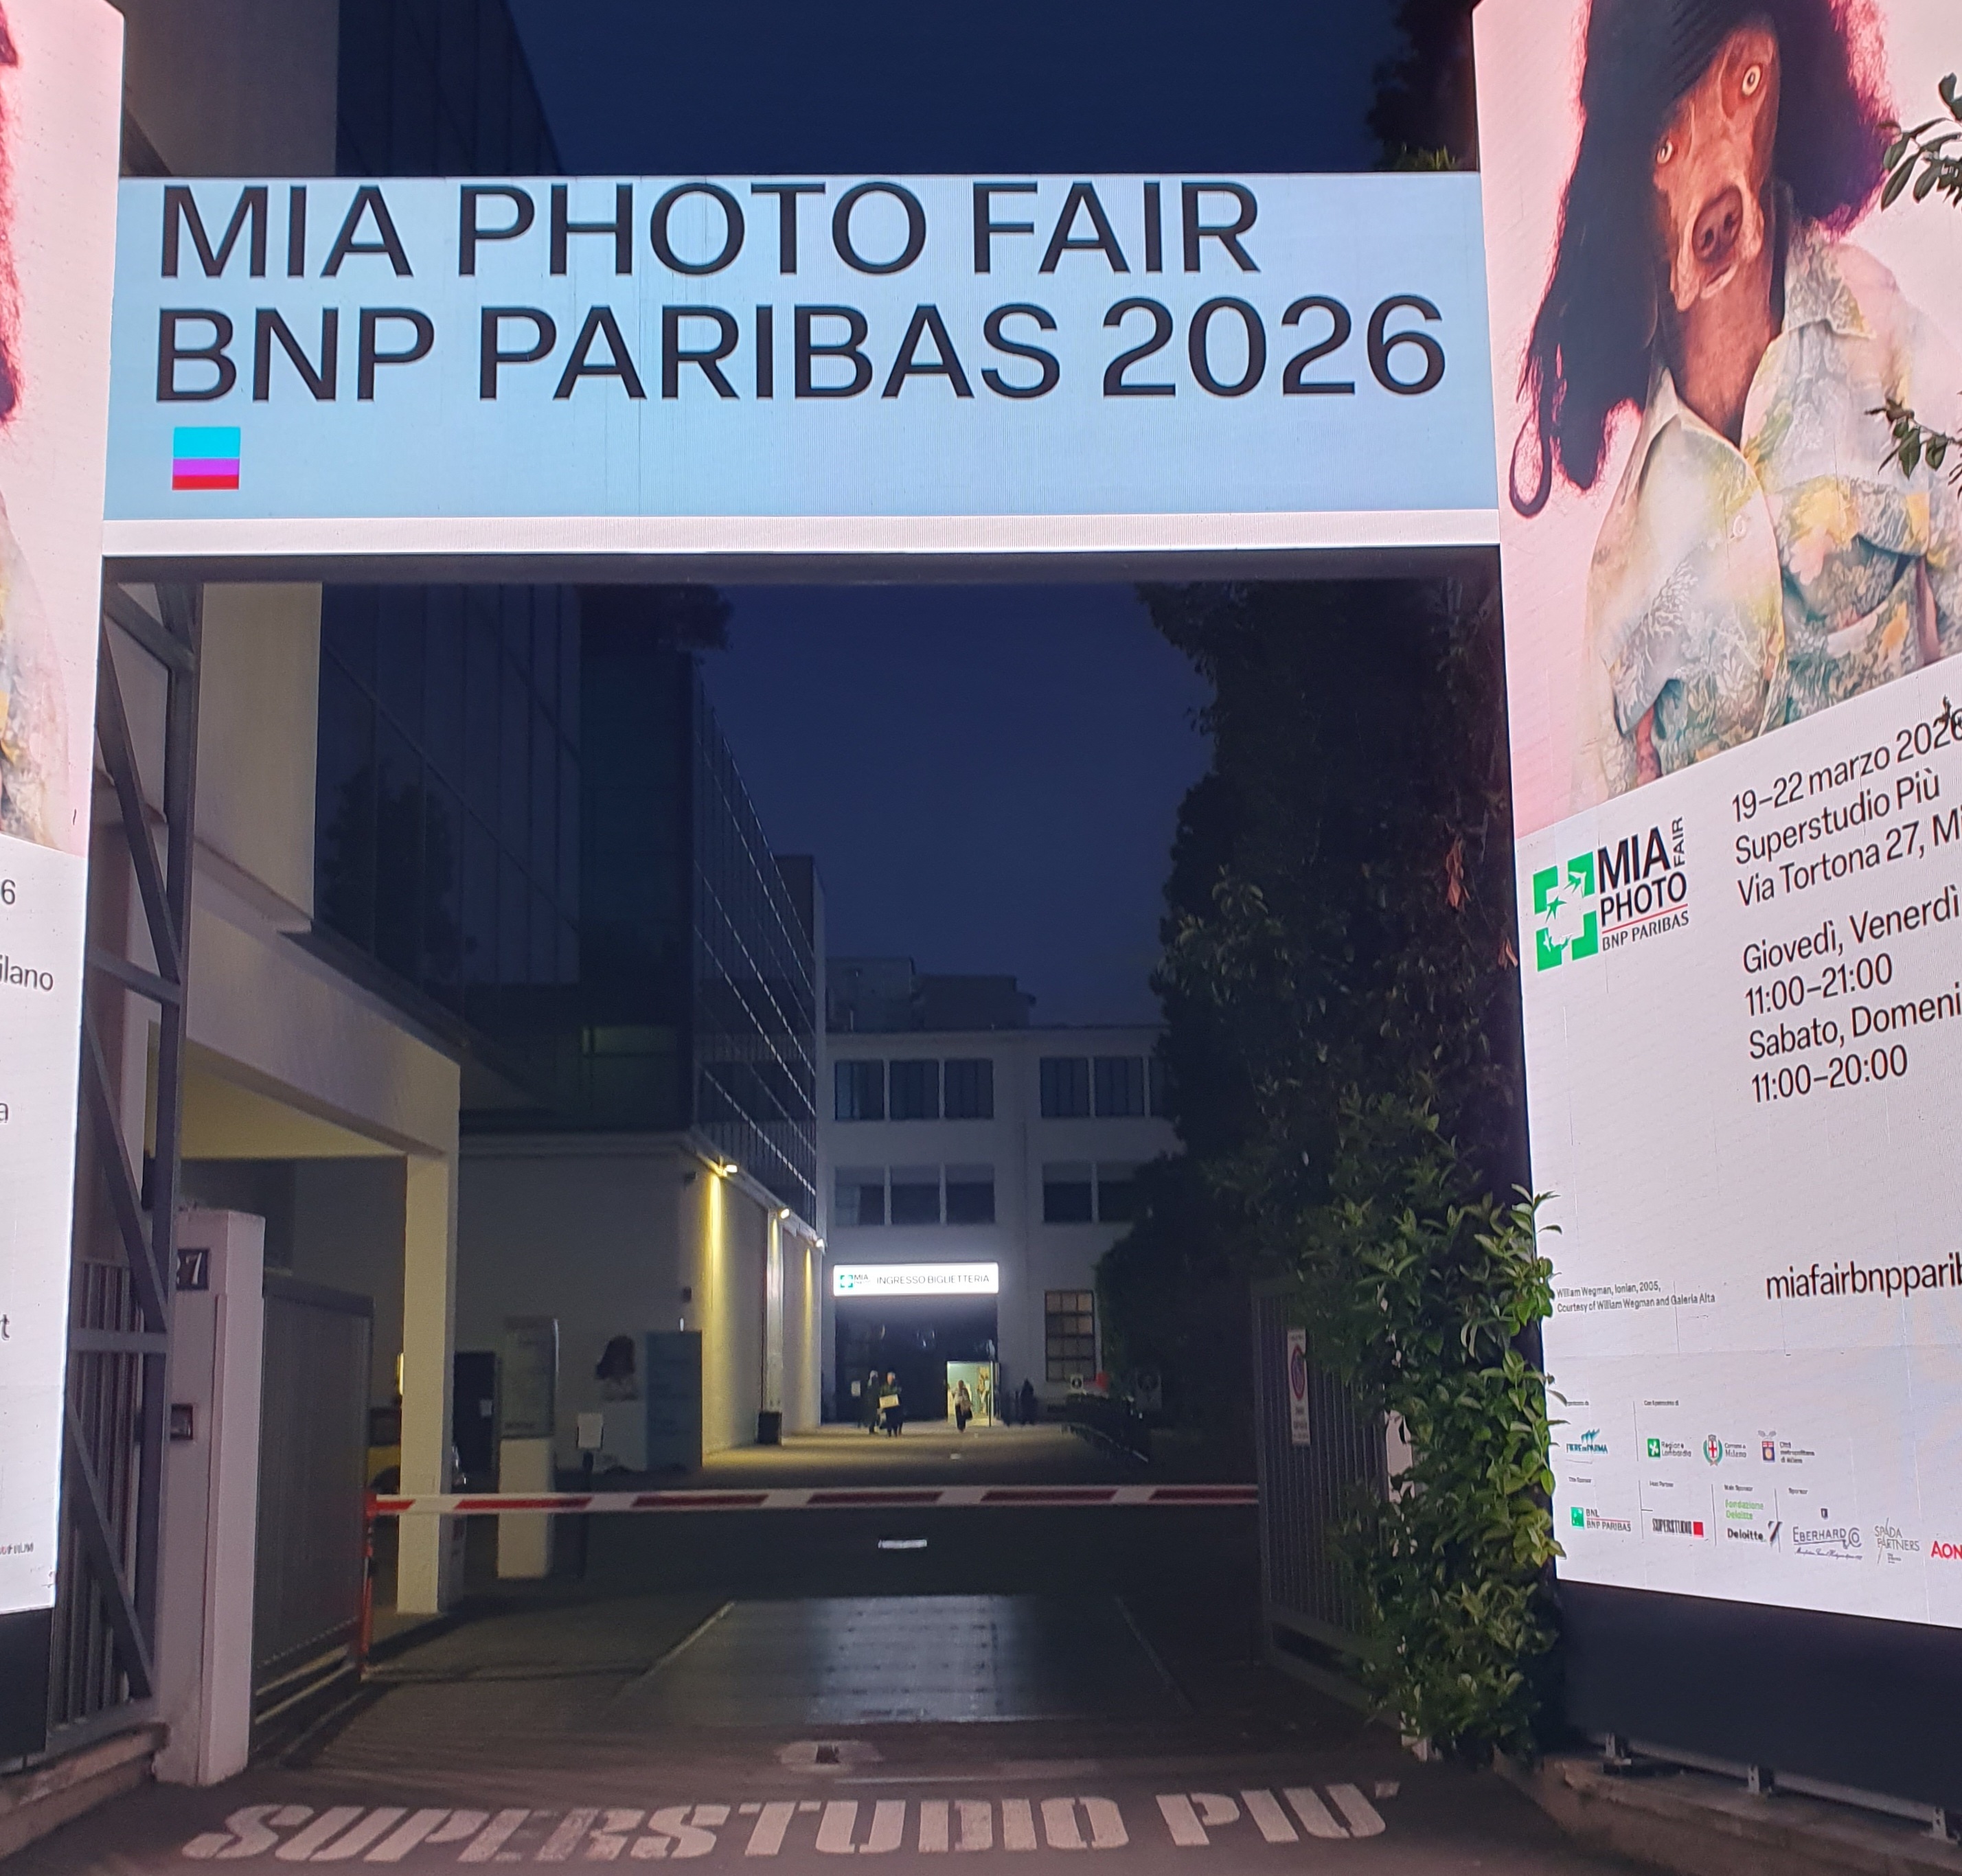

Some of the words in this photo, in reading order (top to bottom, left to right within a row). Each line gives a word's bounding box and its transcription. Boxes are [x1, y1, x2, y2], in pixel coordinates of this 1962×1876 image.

[161, 185, 414, 278] MIA
[457, 181, 927, 277] PHOTO
[972, 181, 1261, 274] FAIR
[157, 306, 435, 403] BNP
[479, 302, 1061, 400] PARIBAS
[1102, 293, 1446, 398] 2026
[1809, 746, 1890, 796] marzo
[1672, 816, 1685, 867] FAIR
[1735, 788, 1889, 865] Superstudio
[1896, 767, 1940, 810] Più
[1597, 826, 1672, 895] MIA
[1737, 872, 1775, 906] Via
[1779, 843, 1880, 893] Tortona
[1885, 820, 1924, 861] 27,
[1600, 871, 1687, 928] PHOTO
[1602, 930, 1628, 952] BNP
[1632, 910, 1689, 942] PARIBAS
[1743, 919, 1843, 973] Giovedì,
[1849, 884, 1959, 943] Venerdì
[1750, 1018, 1845, 1060] Sabato,
[1851, 981, 1962, 1038] Domeni
[877, 1276, 926, 1285] INGRESSO
[928, 1274, 990, 1284] BIGLIETTERIA
[1557, 1302, 1588, 1313] Courtesy
[1588, 1300, 1596, 1311] of
[1597, 1299, 1622, 1310] William
[1623, 1298, 1655, 1309] Wegman
[1656, 1295, 1669, 1306] and
[1699, 1292, 1715, 1303] Alta
[1639, 1281, 1661, 1292] 2005,
[1586, 1509, 1599, 1518] BNL
[1586, 1521, 1601, 1530] BNP
[1602, 1522, 1632, 1532] PARIBAS
[1792, 1526, 1847, 1543] EBERHARD
[182, 1796, 1130, 1862] SUPERSTUDIO
